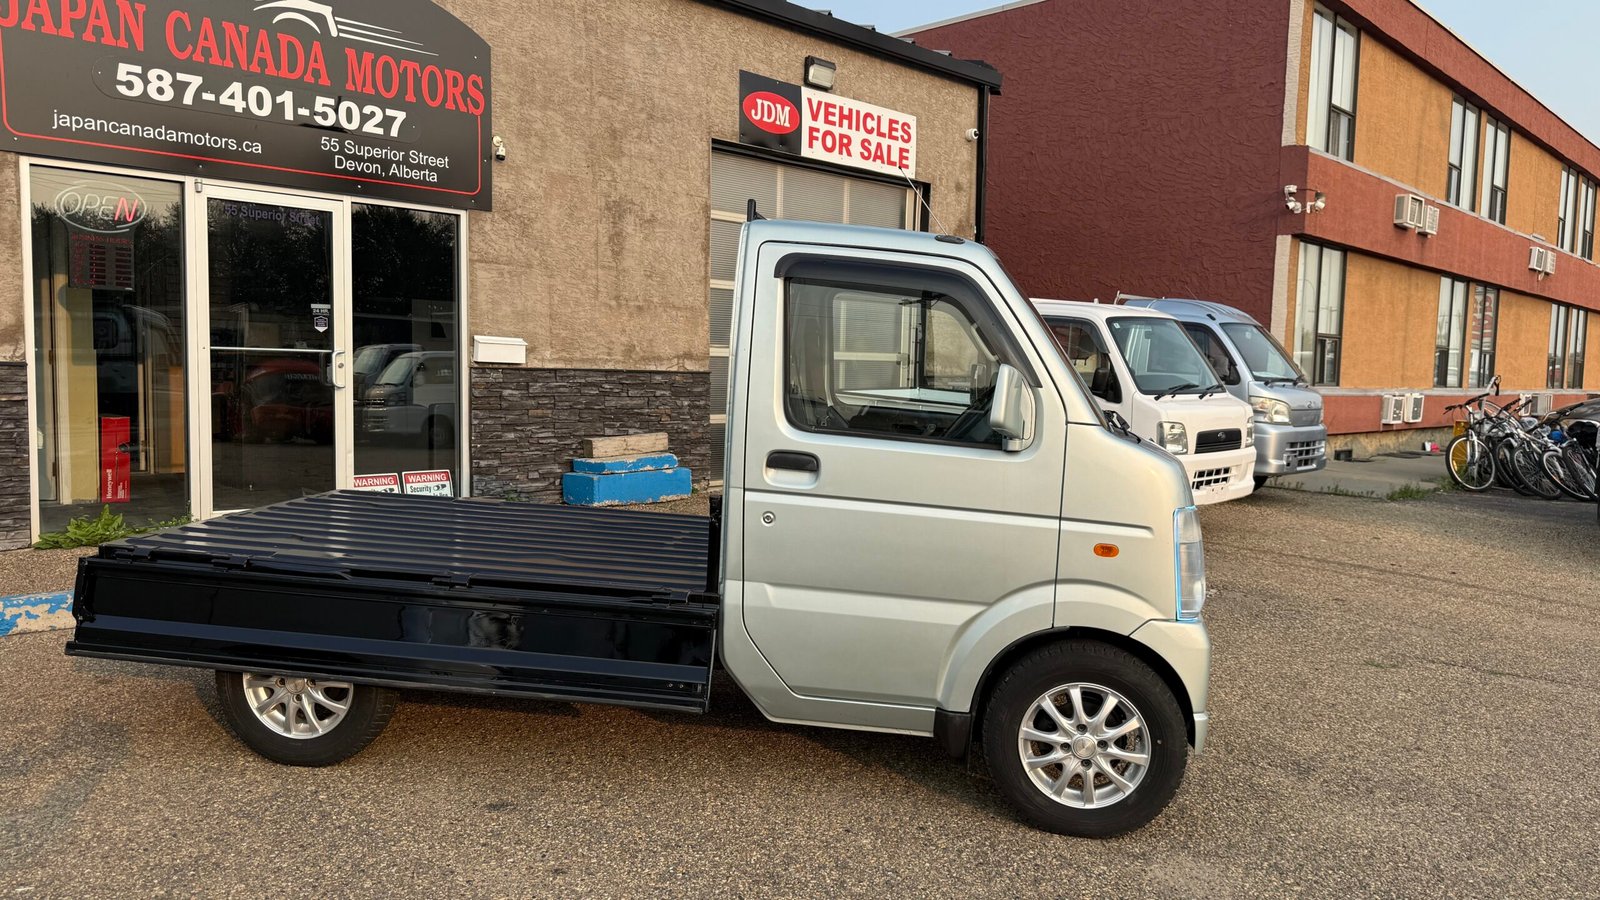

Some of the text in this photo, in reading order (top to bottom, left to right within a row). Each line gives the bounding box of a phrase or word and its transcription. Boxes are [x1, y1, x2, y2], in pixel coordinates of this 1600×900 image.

[0, 0, 485, 116] JAPAN CANADA MOTORS
[115, 62, 407, 138] 587-401-5027
[750, 98, 791, 128] JDM
[52, 109, 262, 154] japancanadamotors.ca
[806, 97, 912, 144] VEHICLES
[320, 136, 450, 169] 55 Superior Street
[808, 125, 910, 170] FOR SALE
[334, 154, 438, 182] Devon, Alberta
[60, 191, 139, 222] OPEN
[224, 203, 320, 225] 55 Superior Street
[354, 477, 395, 487] WARNING
[408, 473, 447, 483] WARNING
[410, 485, 431, 493] Security
